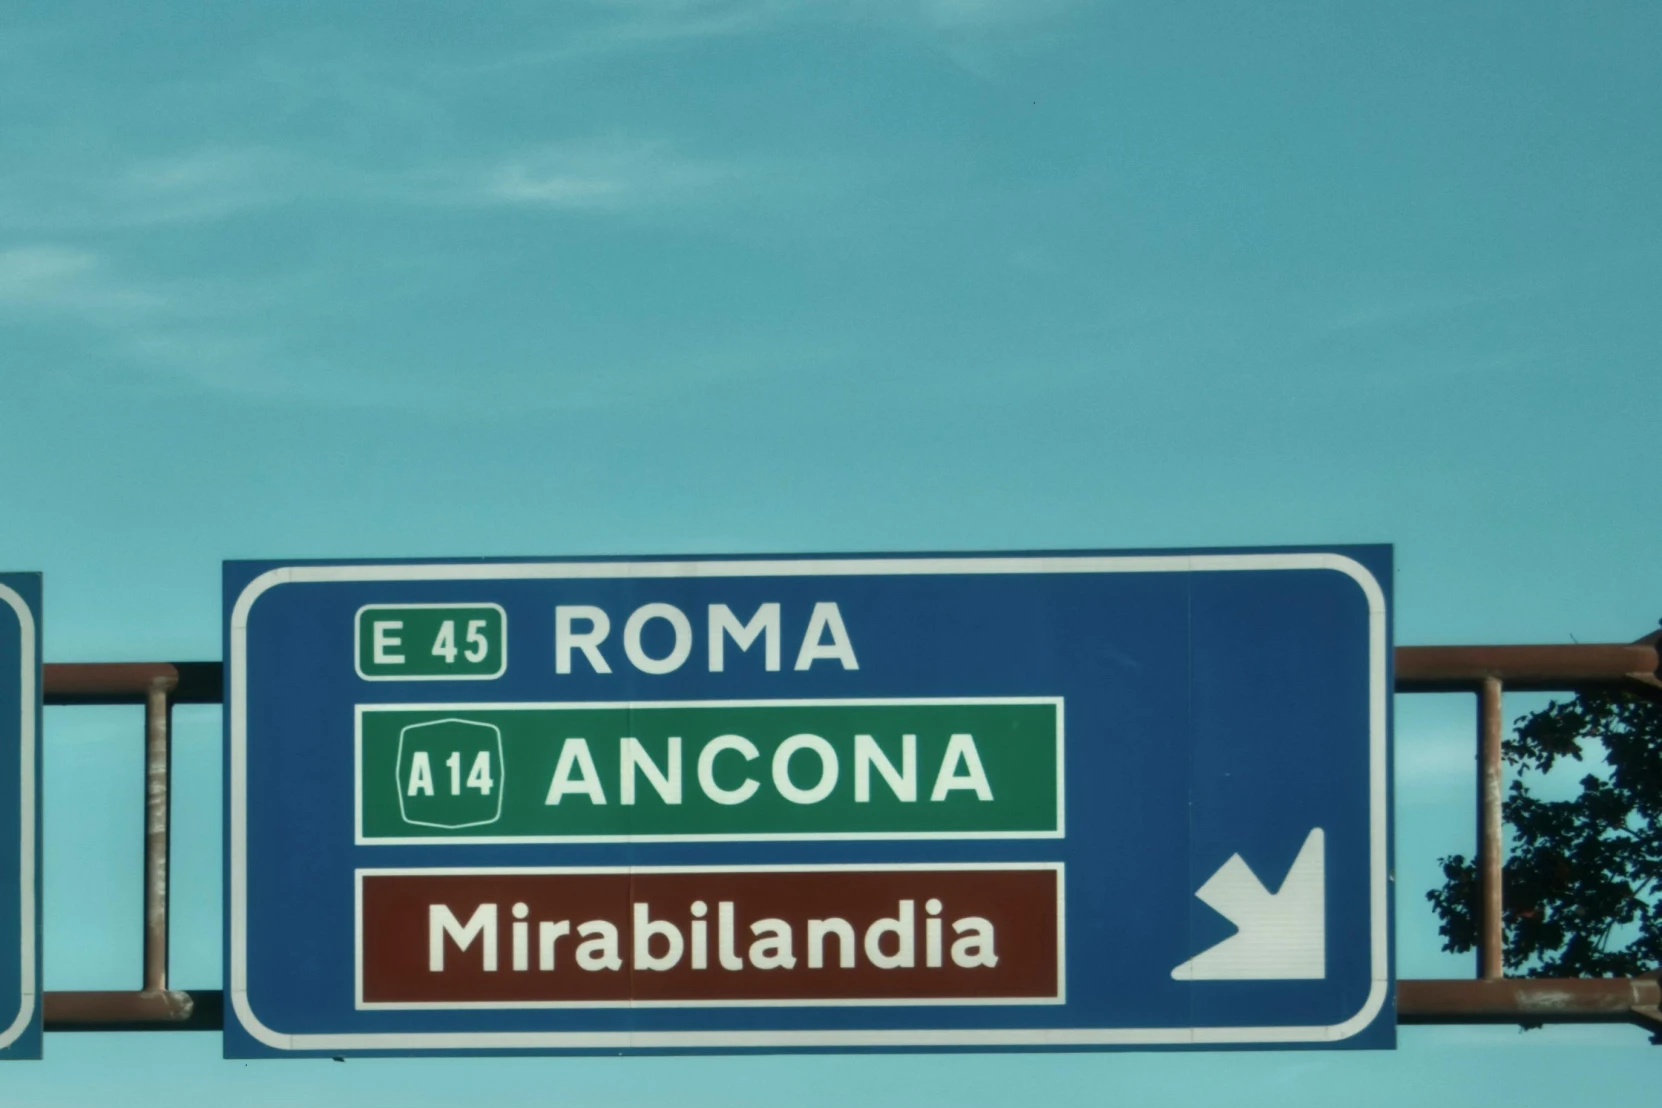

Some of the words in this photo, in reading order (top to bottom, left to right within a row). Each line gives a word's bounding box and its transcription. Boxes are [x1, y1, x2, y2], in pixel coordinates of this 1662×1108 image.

[373, 620, 406, 664] E
[431, 619, 488, 663] 45
[555, 601, 859, 675] ROMA
[407, 751, 434, 797] A
[446, 750, 494, 796] 14
[545, 733, 994, 806] ANCONA
[428, 898, 999, 972] Mirabilandia
